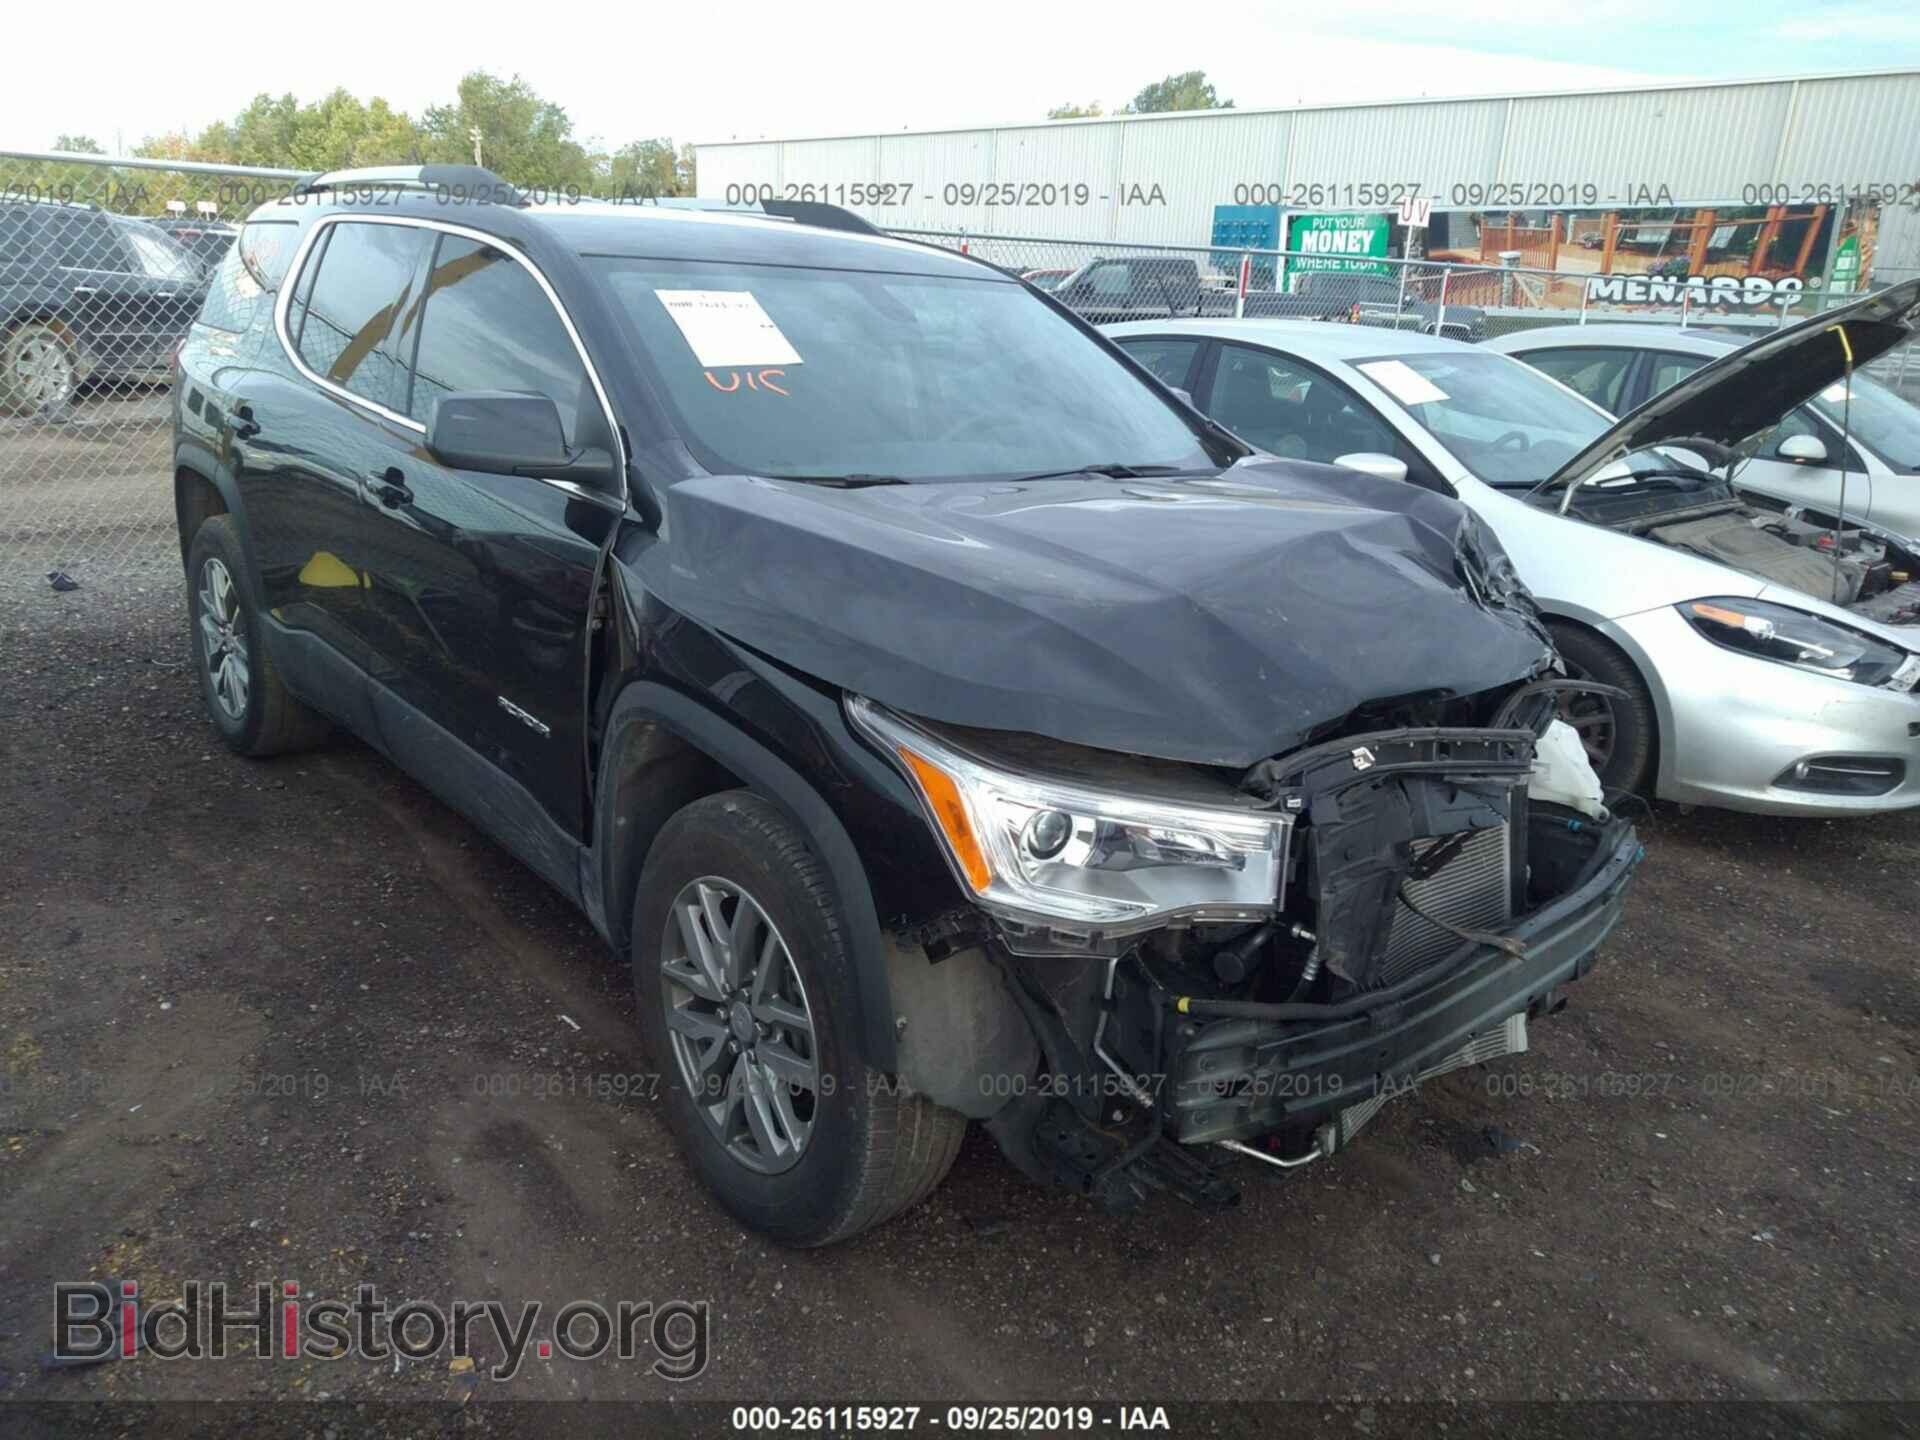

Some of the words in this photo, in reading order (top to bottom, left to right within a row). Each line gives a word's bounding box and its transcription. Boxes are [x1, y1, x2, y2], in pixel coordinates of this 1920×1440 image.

[1312, 217, 1334, 228] PUT
[1335, 217, 1365, 228] YOUR
[1301, 230, 1375, 253] MONEY
[1588, 274, 1804, 305] MENARDS
